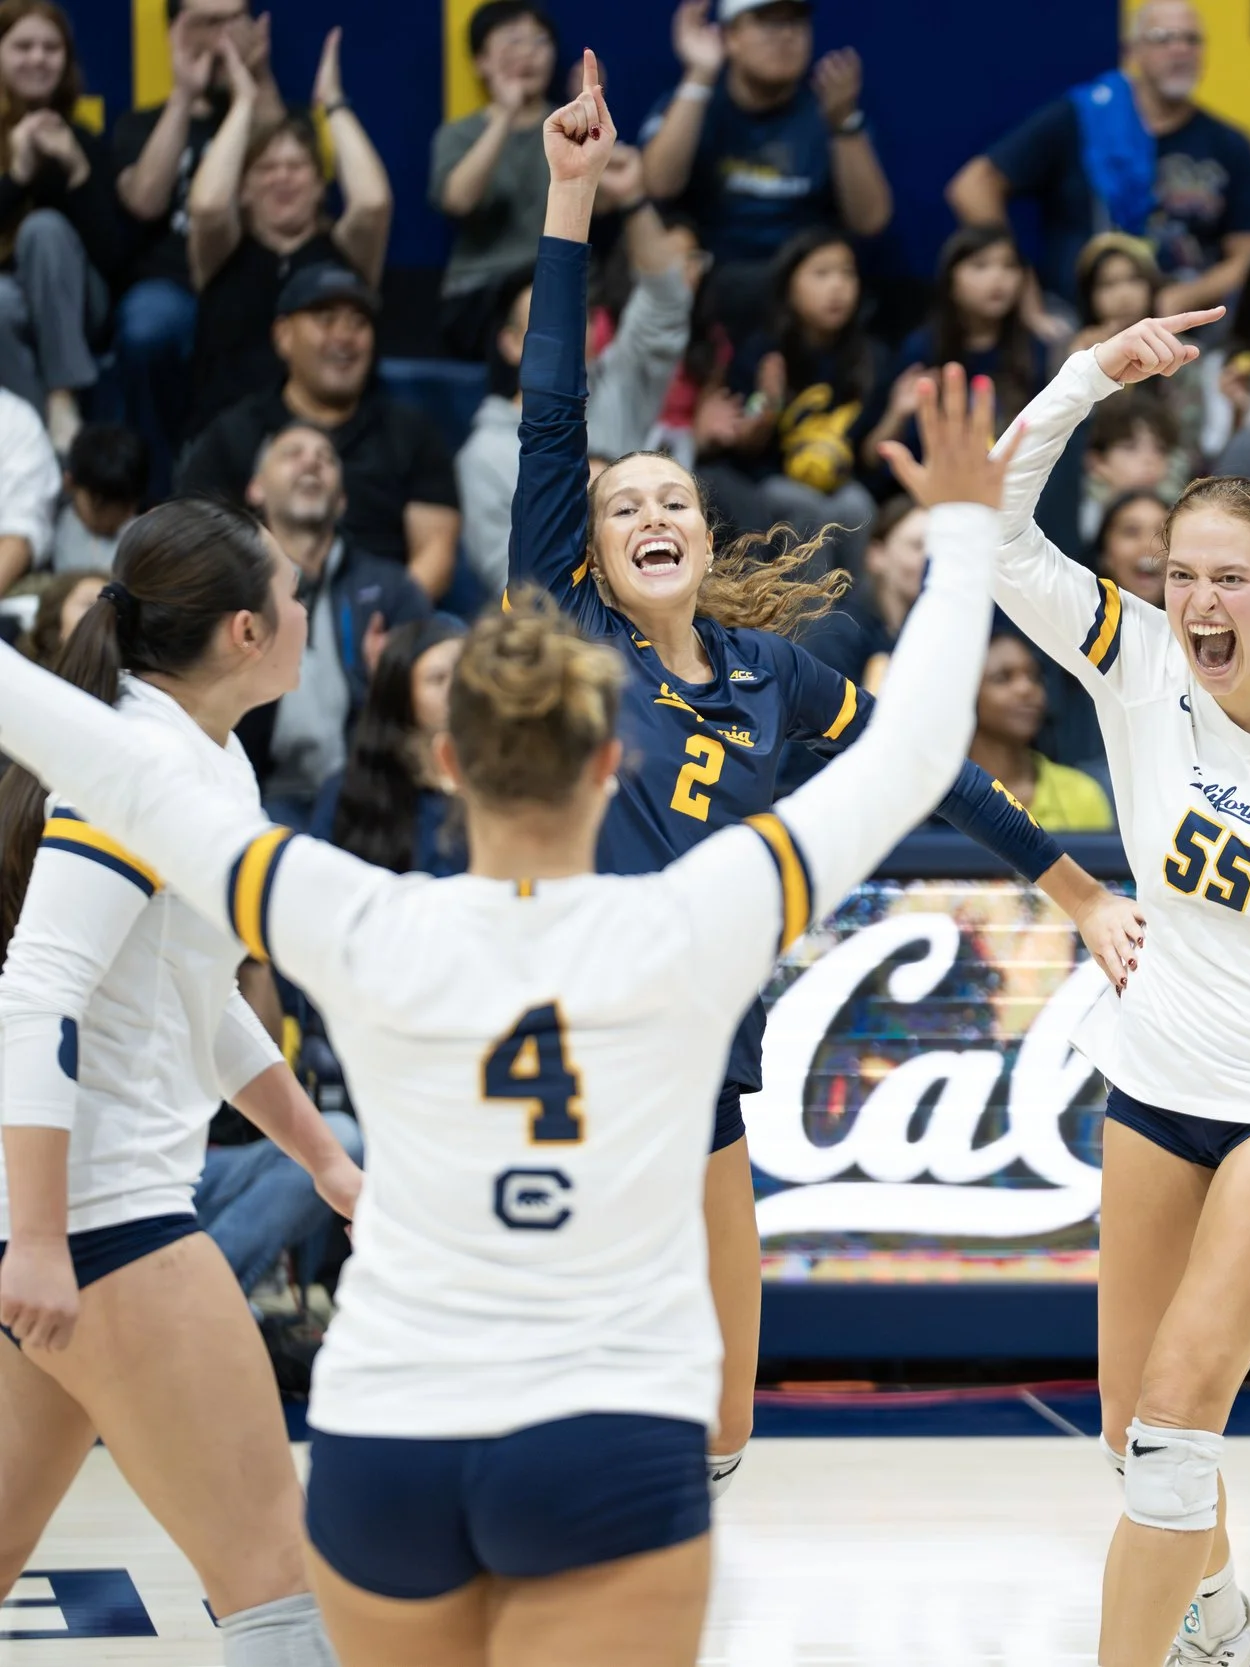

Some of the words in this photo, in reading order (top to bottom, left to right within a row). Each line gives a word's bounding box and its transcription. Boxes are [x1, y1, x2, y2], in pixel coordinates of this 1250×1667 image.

[729, 669, 758, 682] ACC
[669, 733, 727, 823] 2
[480, 997, 586, 1146] 4
[492, 1166, 574, 1231] C
